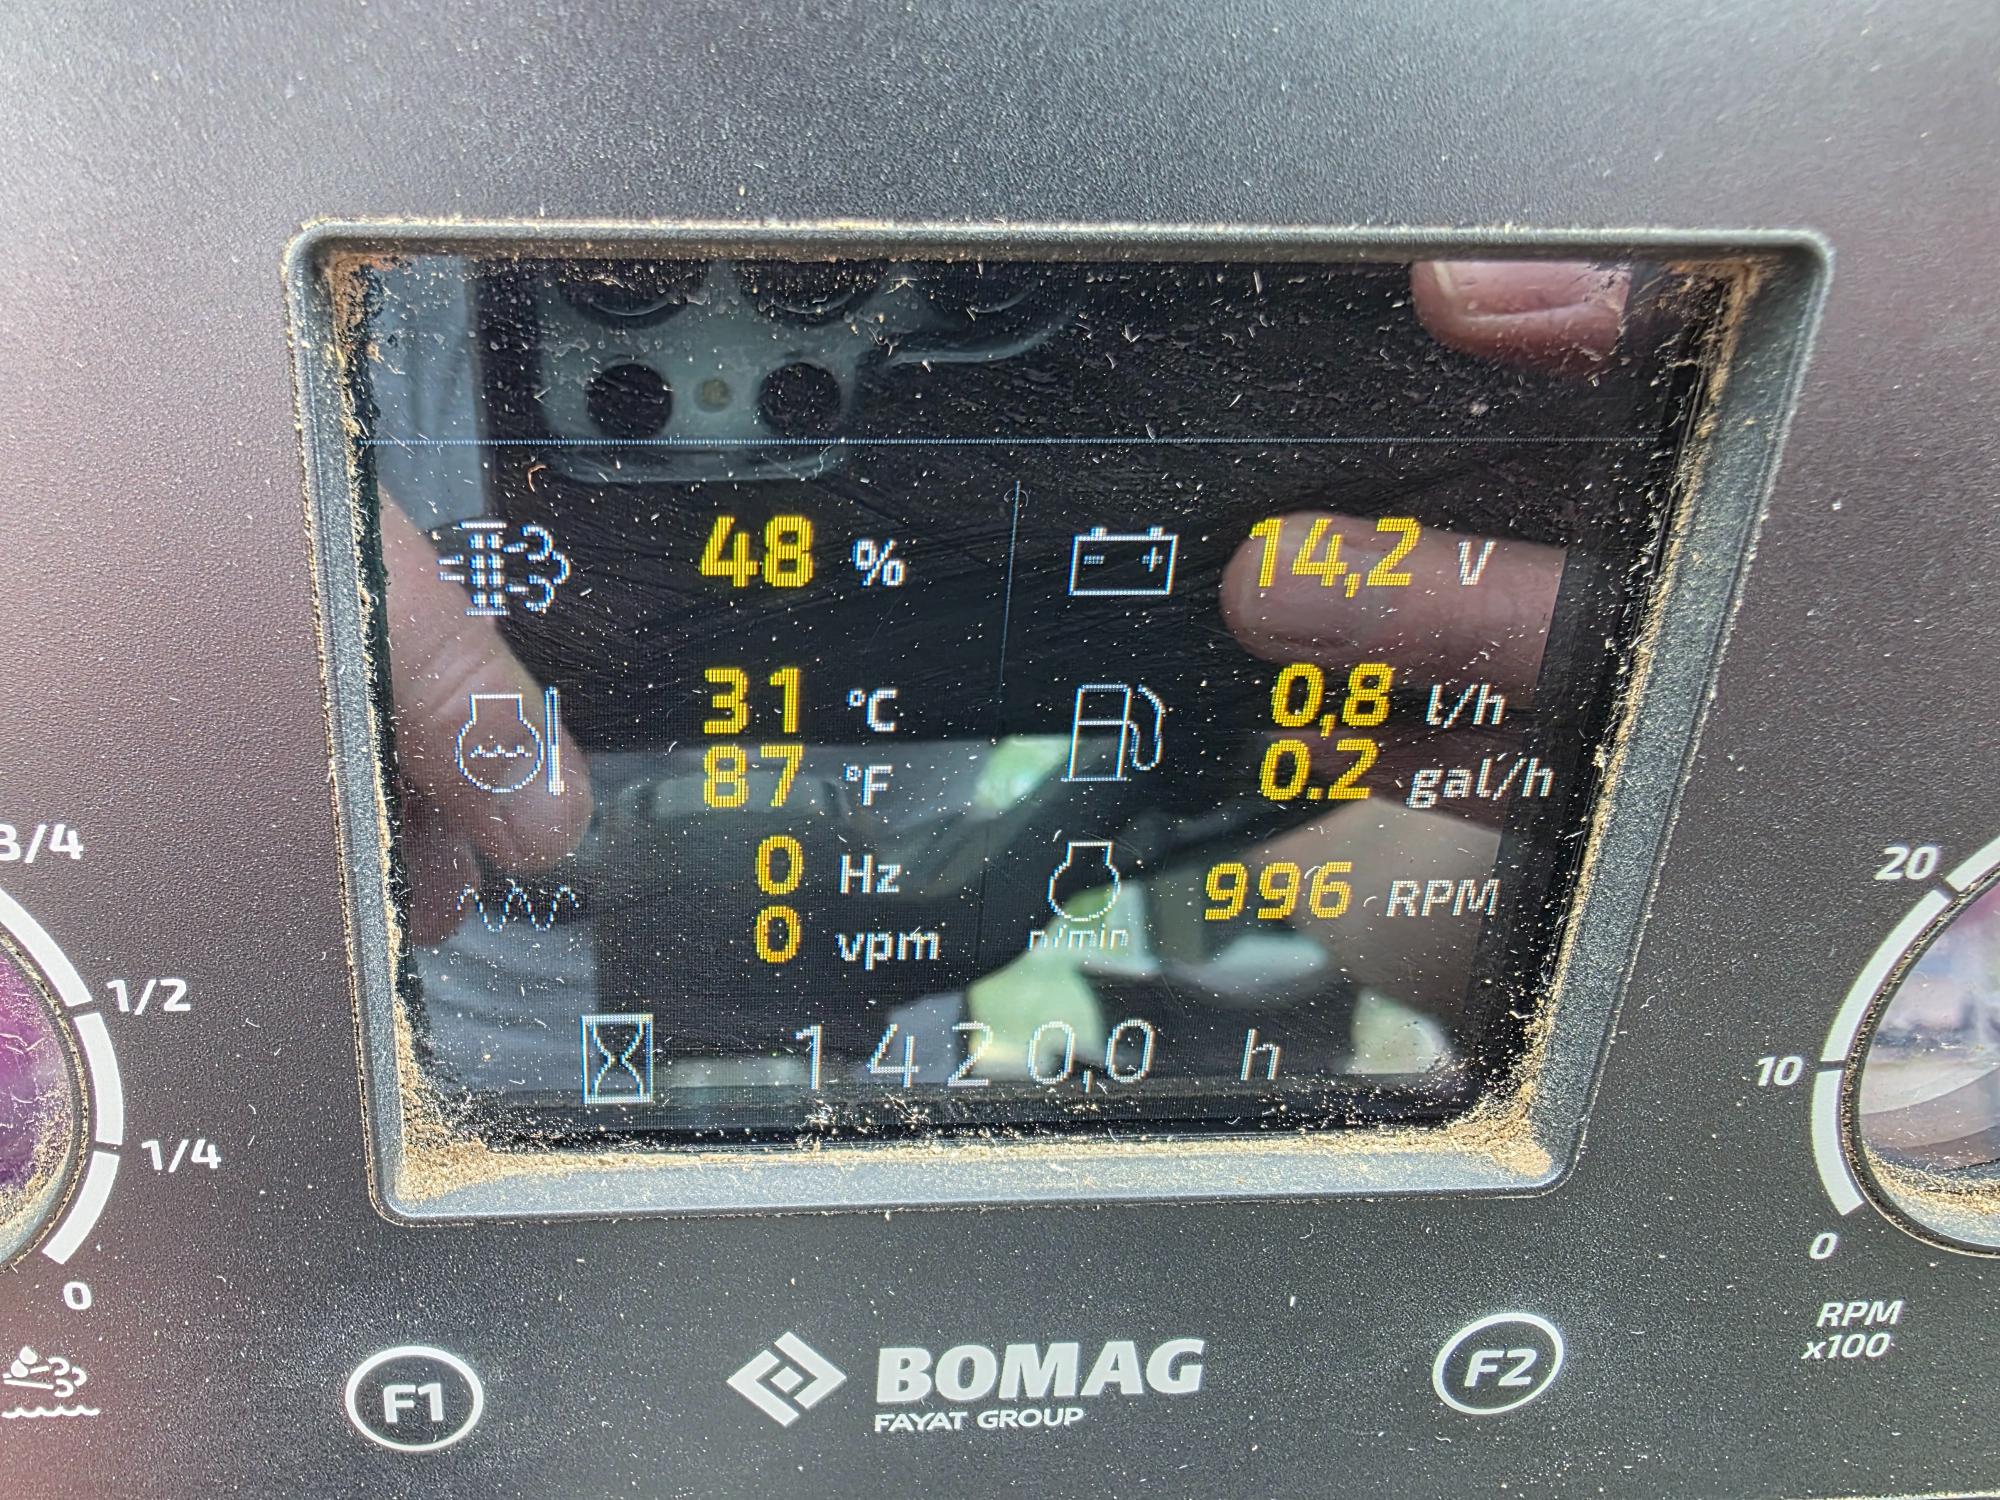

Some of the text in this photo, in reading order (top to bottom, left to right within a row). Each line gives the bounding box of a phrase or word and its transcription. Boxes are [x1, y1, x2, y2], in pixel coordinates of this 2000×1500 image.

[700, 515, 906, 587] 48 %
[1250, 517, 1496, 597] 14,2 V
[703, 667, 897, 734] 31 °C
[1270, 663, 1508, 737] 0,8 l/h
[703, 745, 893, 809] 87 °F
[1259, 739, 1555, 808] 0.2 gal/h
[0, 823, 84, 864] 3/4
[1873, 846, 1940, 882] 20
[755, 835, 901, 896] 0 Hz
[1204, 861, 1500, 921] 996 RPM
[753, 905, 940, 970] 0 vpm
[1027, 923, 1129, 951] n/min
[106, 978, 191, 1015] 1/2
[1240, 1028, 1281, 1081] h
[1755, 1056, 1803, 1087] 10
[141, 1139, 222, 1171] 1/4
[1808, 1233, 1838, 1260] 0
[63, 1281, 93, 1311] 0
[1816, 1300, 1903, 1327] RPM
[1801, 1333, 1891, 1360] x100
[875, 1338, 1206, 1403] BOMAG
[1464, 1349, 1536, 1387] F2
[383, 1382, 444, 1423] F1
[874, 1407, 1085, 1432] FAYAT GROUP
